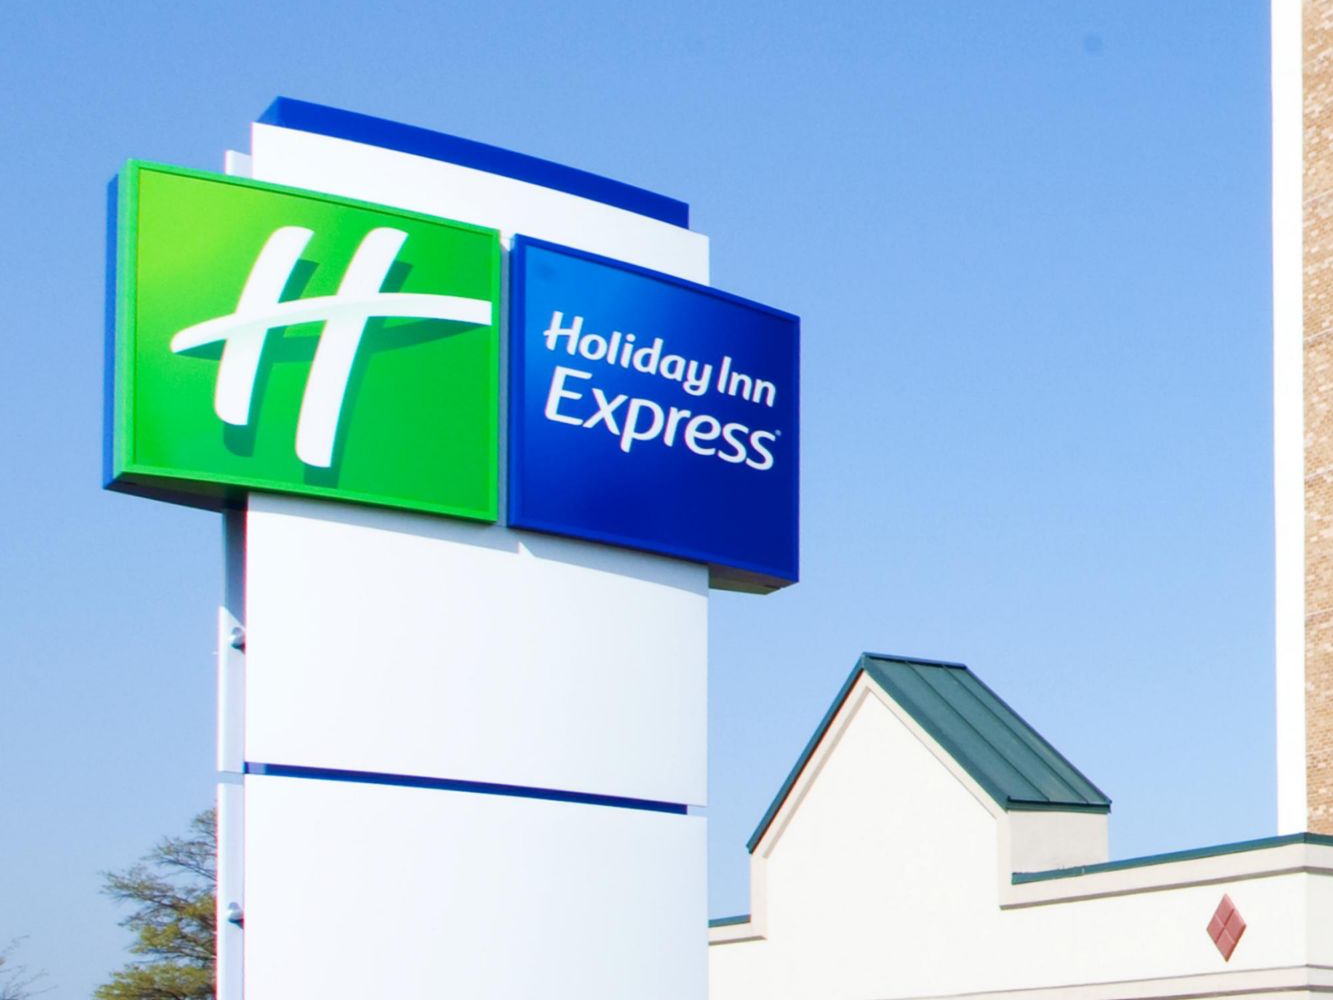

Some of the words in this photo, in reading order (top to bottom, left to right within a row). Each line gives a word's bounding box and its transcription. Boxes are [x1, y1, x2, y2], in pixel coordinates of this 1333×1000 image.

[170, 225, 492, 468] H
[543, 310, 713, 396] Holiday
[717, 355, 776, 407] Inn
[544, 365, 777, 471] Express
